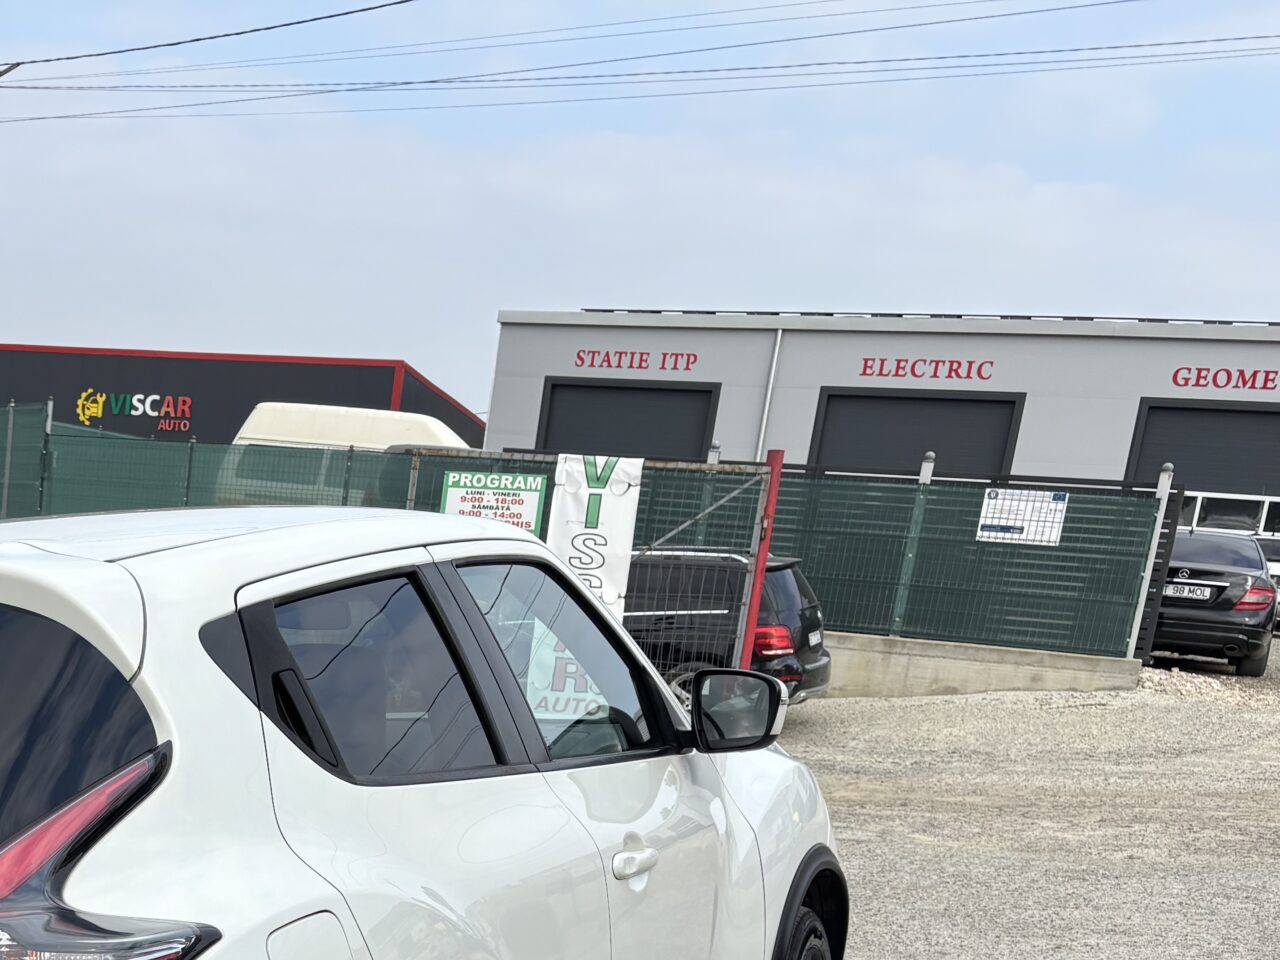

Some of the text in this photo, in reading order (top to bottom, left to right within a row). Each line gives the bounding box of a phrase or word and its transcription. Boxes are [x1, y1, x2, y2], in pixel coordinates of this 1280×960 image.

[574, 349, 698, 371] STATIE ITP
[859, 357, 994, 380] ELECTRIC
[1172, 367, 1280, 390] GEOME
[109, 393, 192, 418] VISCAR
[158, 419, 190, 431] AUTO
[448, 473, 542, 490] PROGRAM
[460, 496, 484, 504] 9:00
[494, 497, 524, 506] 18:00
[492, 511, 522, 520] 14:00
[1172, 585, 1185, 595] 98
[1187, 586, 1208, 598] MOL
[535, 696, 601, 716] AUTO
